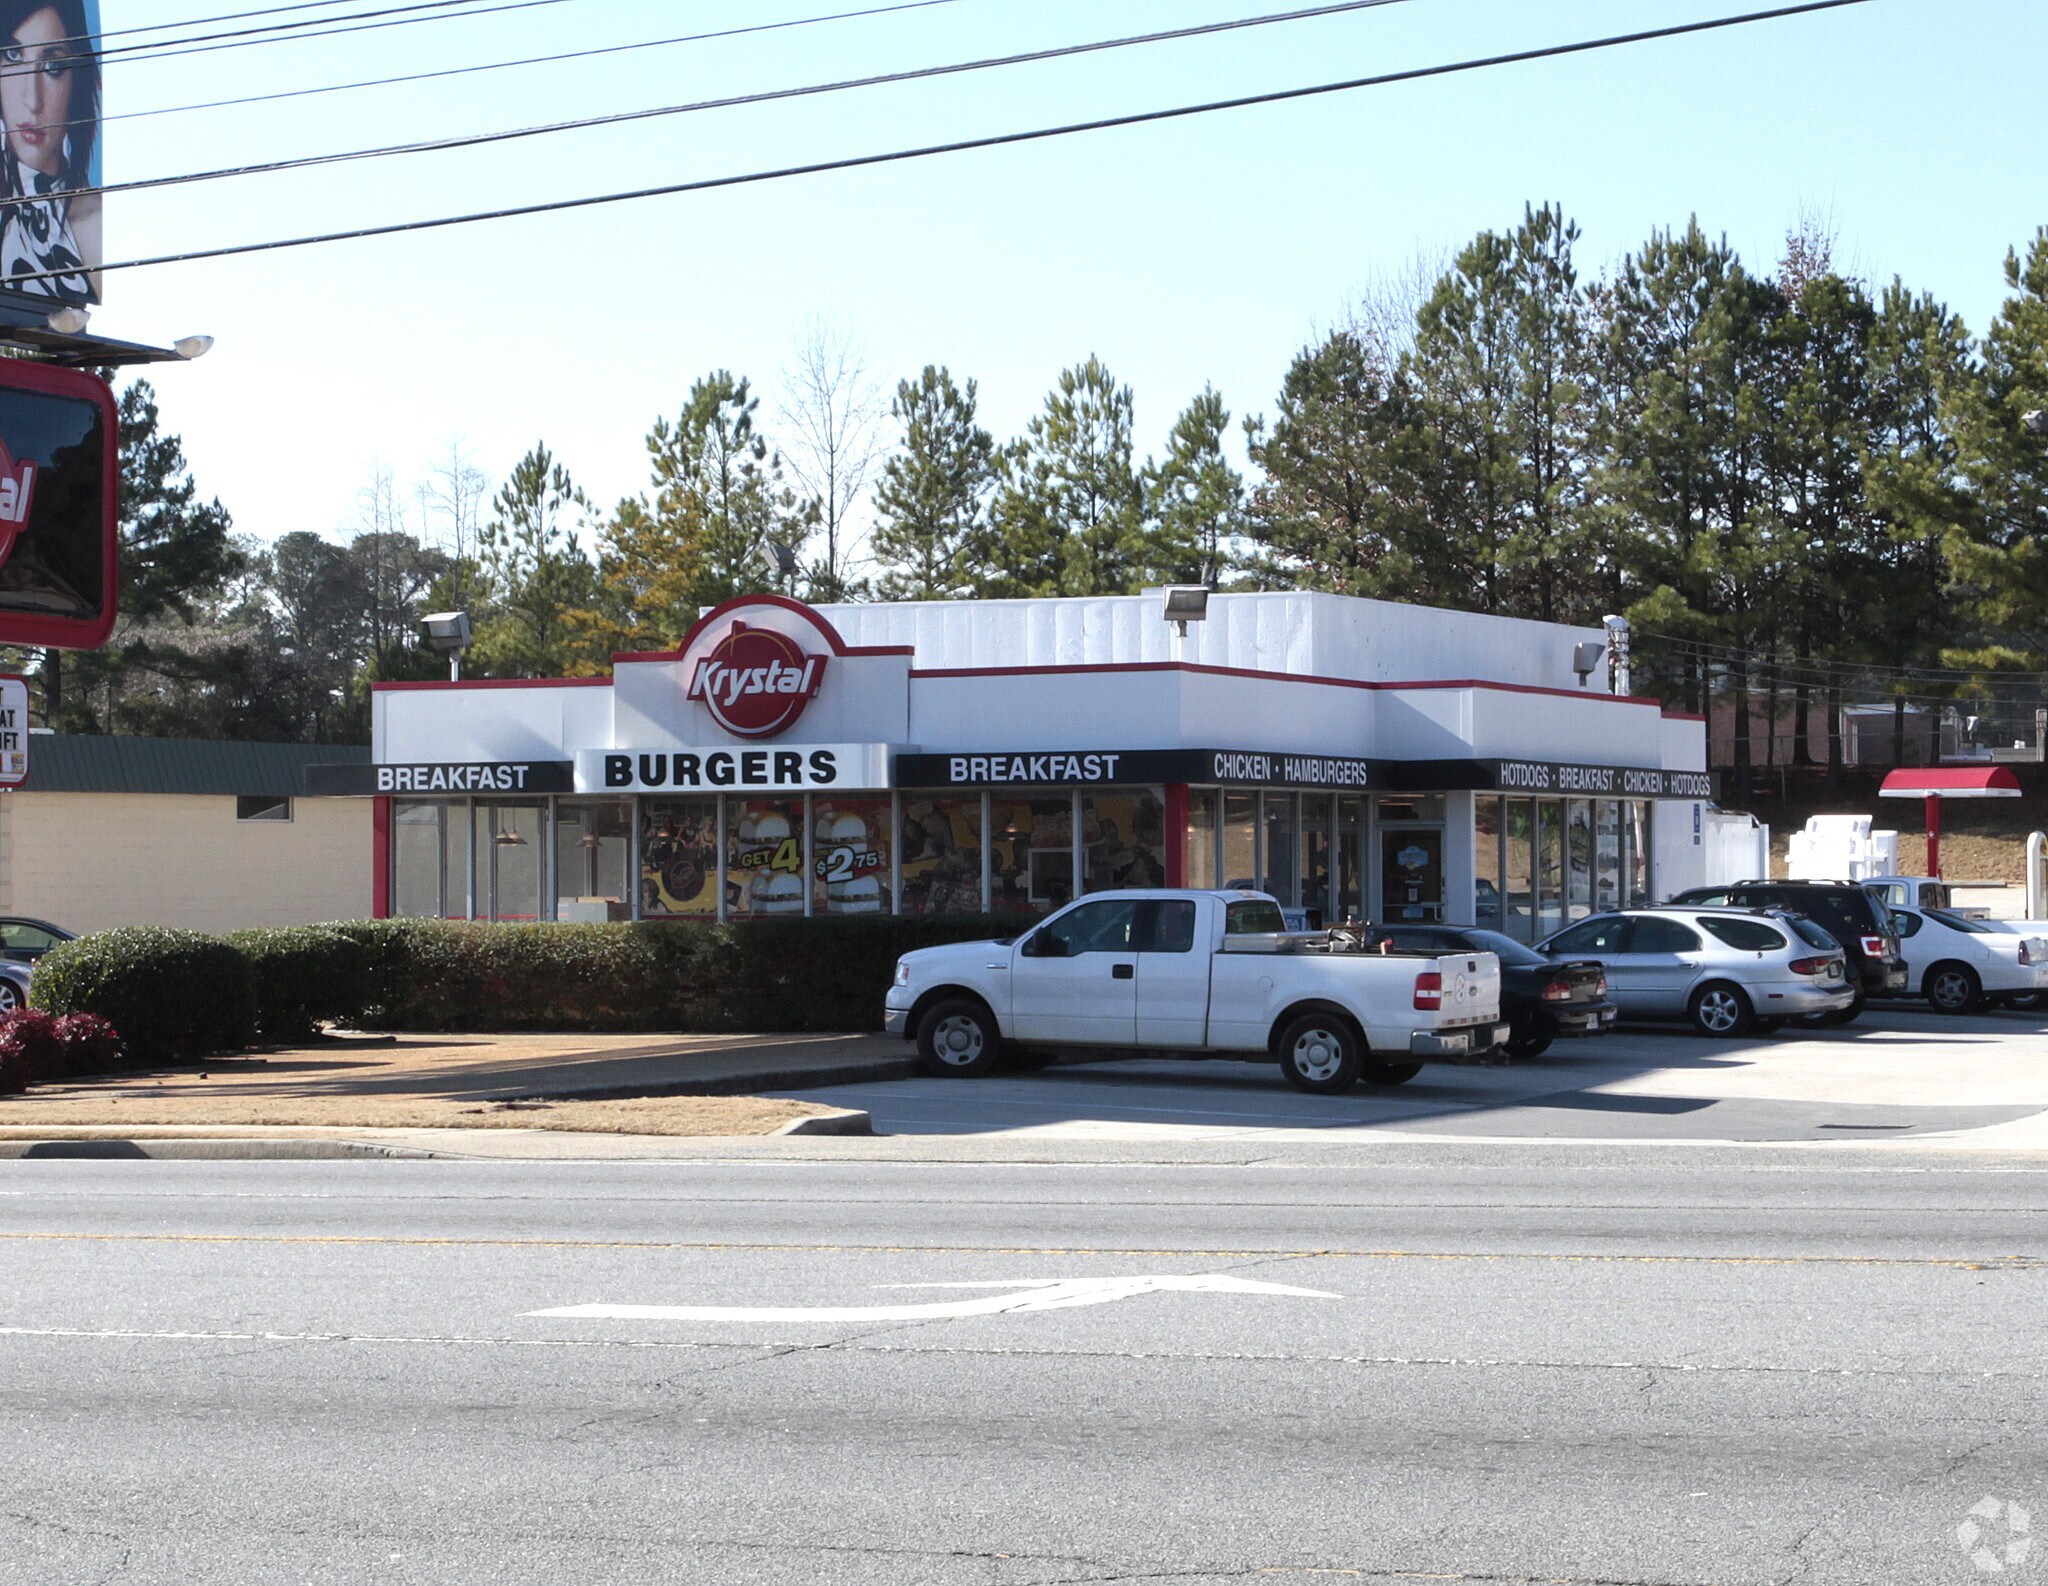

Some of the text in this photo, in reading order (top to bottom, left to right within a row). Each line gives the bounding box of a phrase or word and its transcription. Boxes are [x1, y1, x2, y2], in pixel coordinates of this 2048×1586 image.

[691, 659, 815, 707] Krystal
[377, 765, 529, 792] BREAKFAST
[605, 750, 837, 787] BURGERS
[949, 754, 1120, 783] BREAKFAST
[1214, 753, 1367, 785] CHICKEN HAMBURGERS
[1500, 762, 1711, 796] HOTDOGS BREAKFAST CHICKEN HOTDOGS
[740, 838, 800, 873] GET 4
